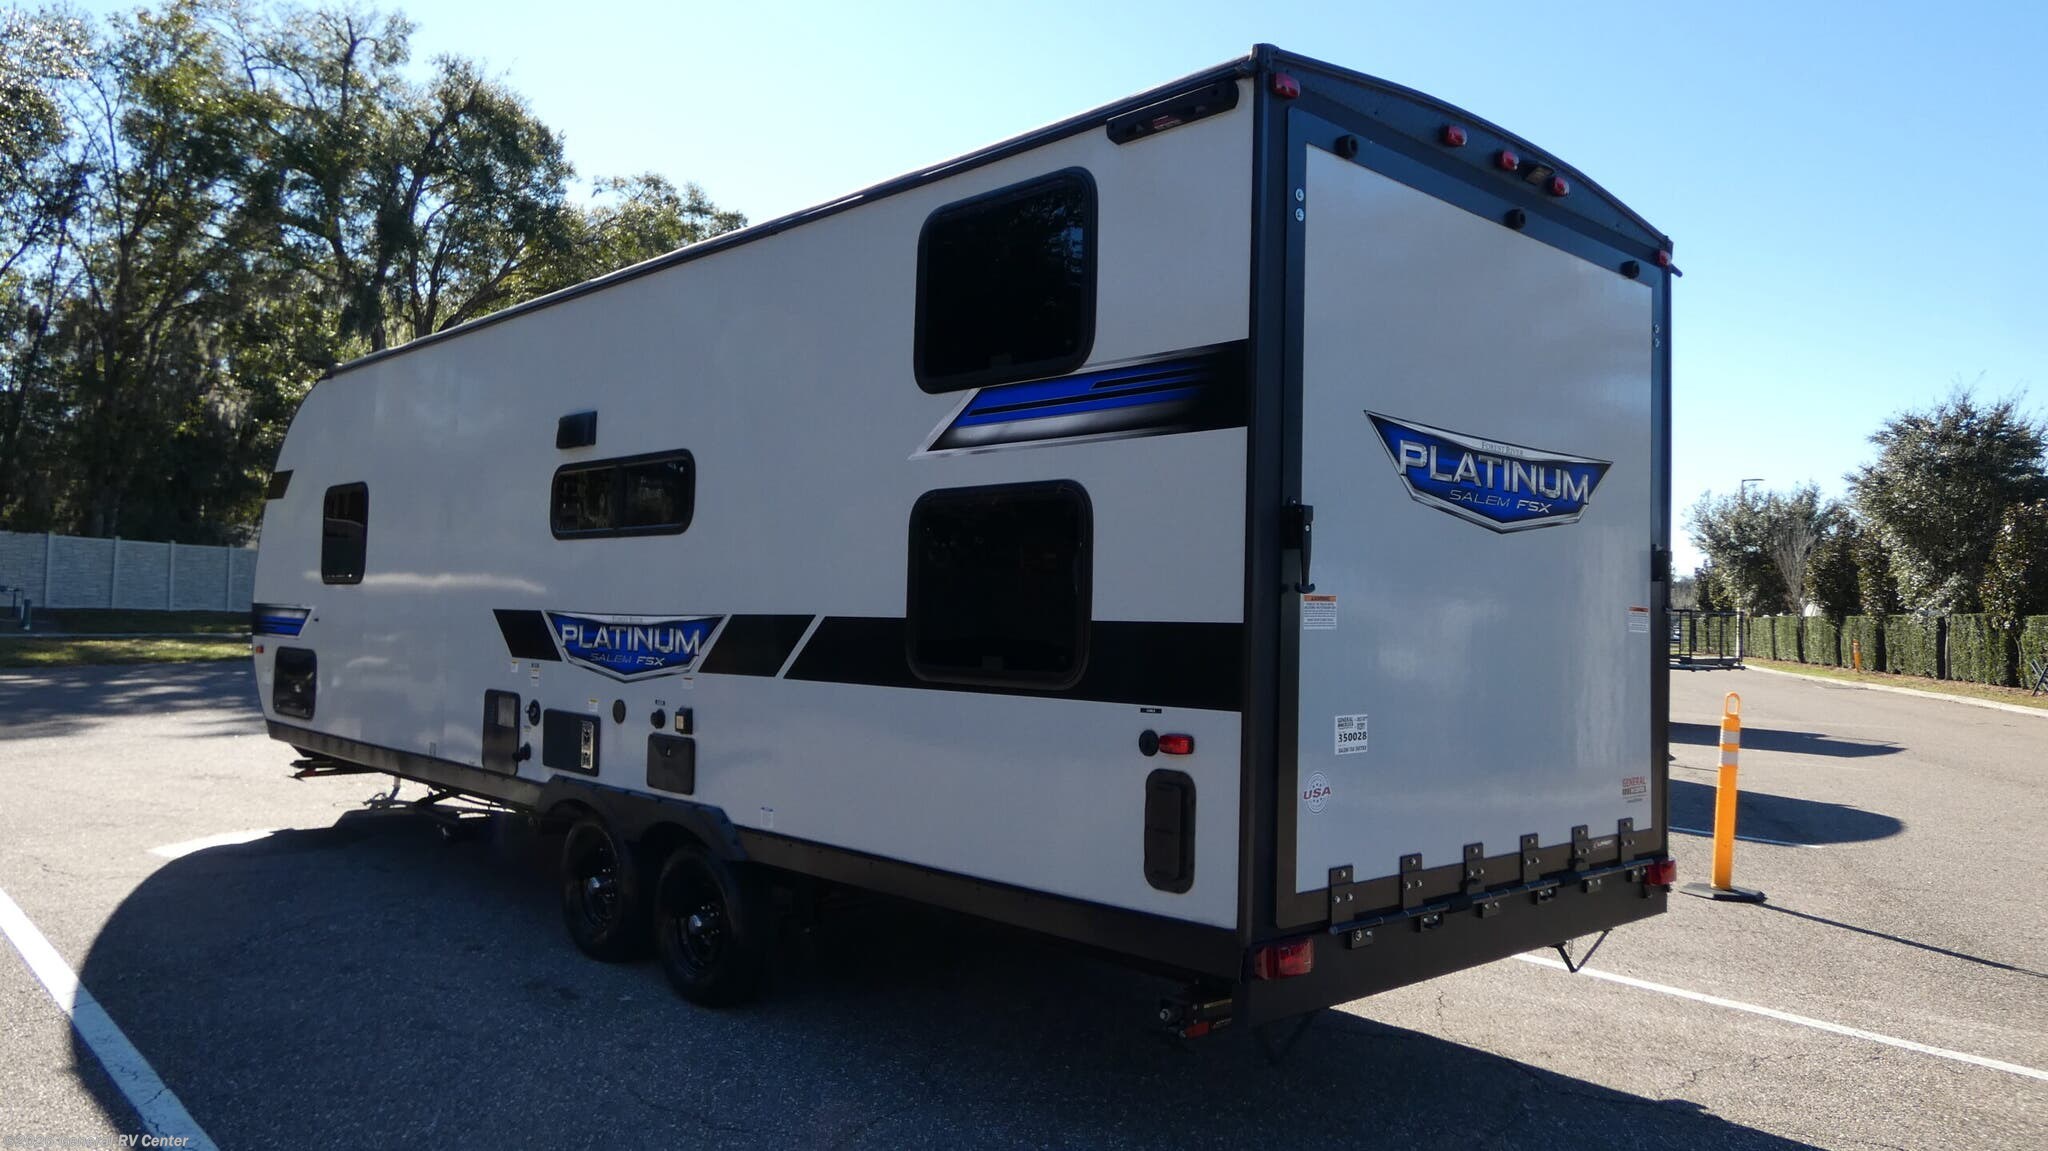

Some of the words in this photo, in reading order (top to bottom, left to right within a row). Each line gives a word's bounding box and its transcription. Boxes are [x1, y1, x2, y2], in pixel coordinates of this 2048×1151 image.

[1400, 439, 1589, 505] PLATINUM
[1449, 489, 1511, 508] SALEM
[1516, 499, 1552, 514] FSX
[562, 624, 700, 656] PLATINUM
[589, 652, 634, 664] SALEM
[635, 655, 665, 667] FSX
[1338, 731, 1367, 743] 350028
[1303, 786, 1331, 800] USA
